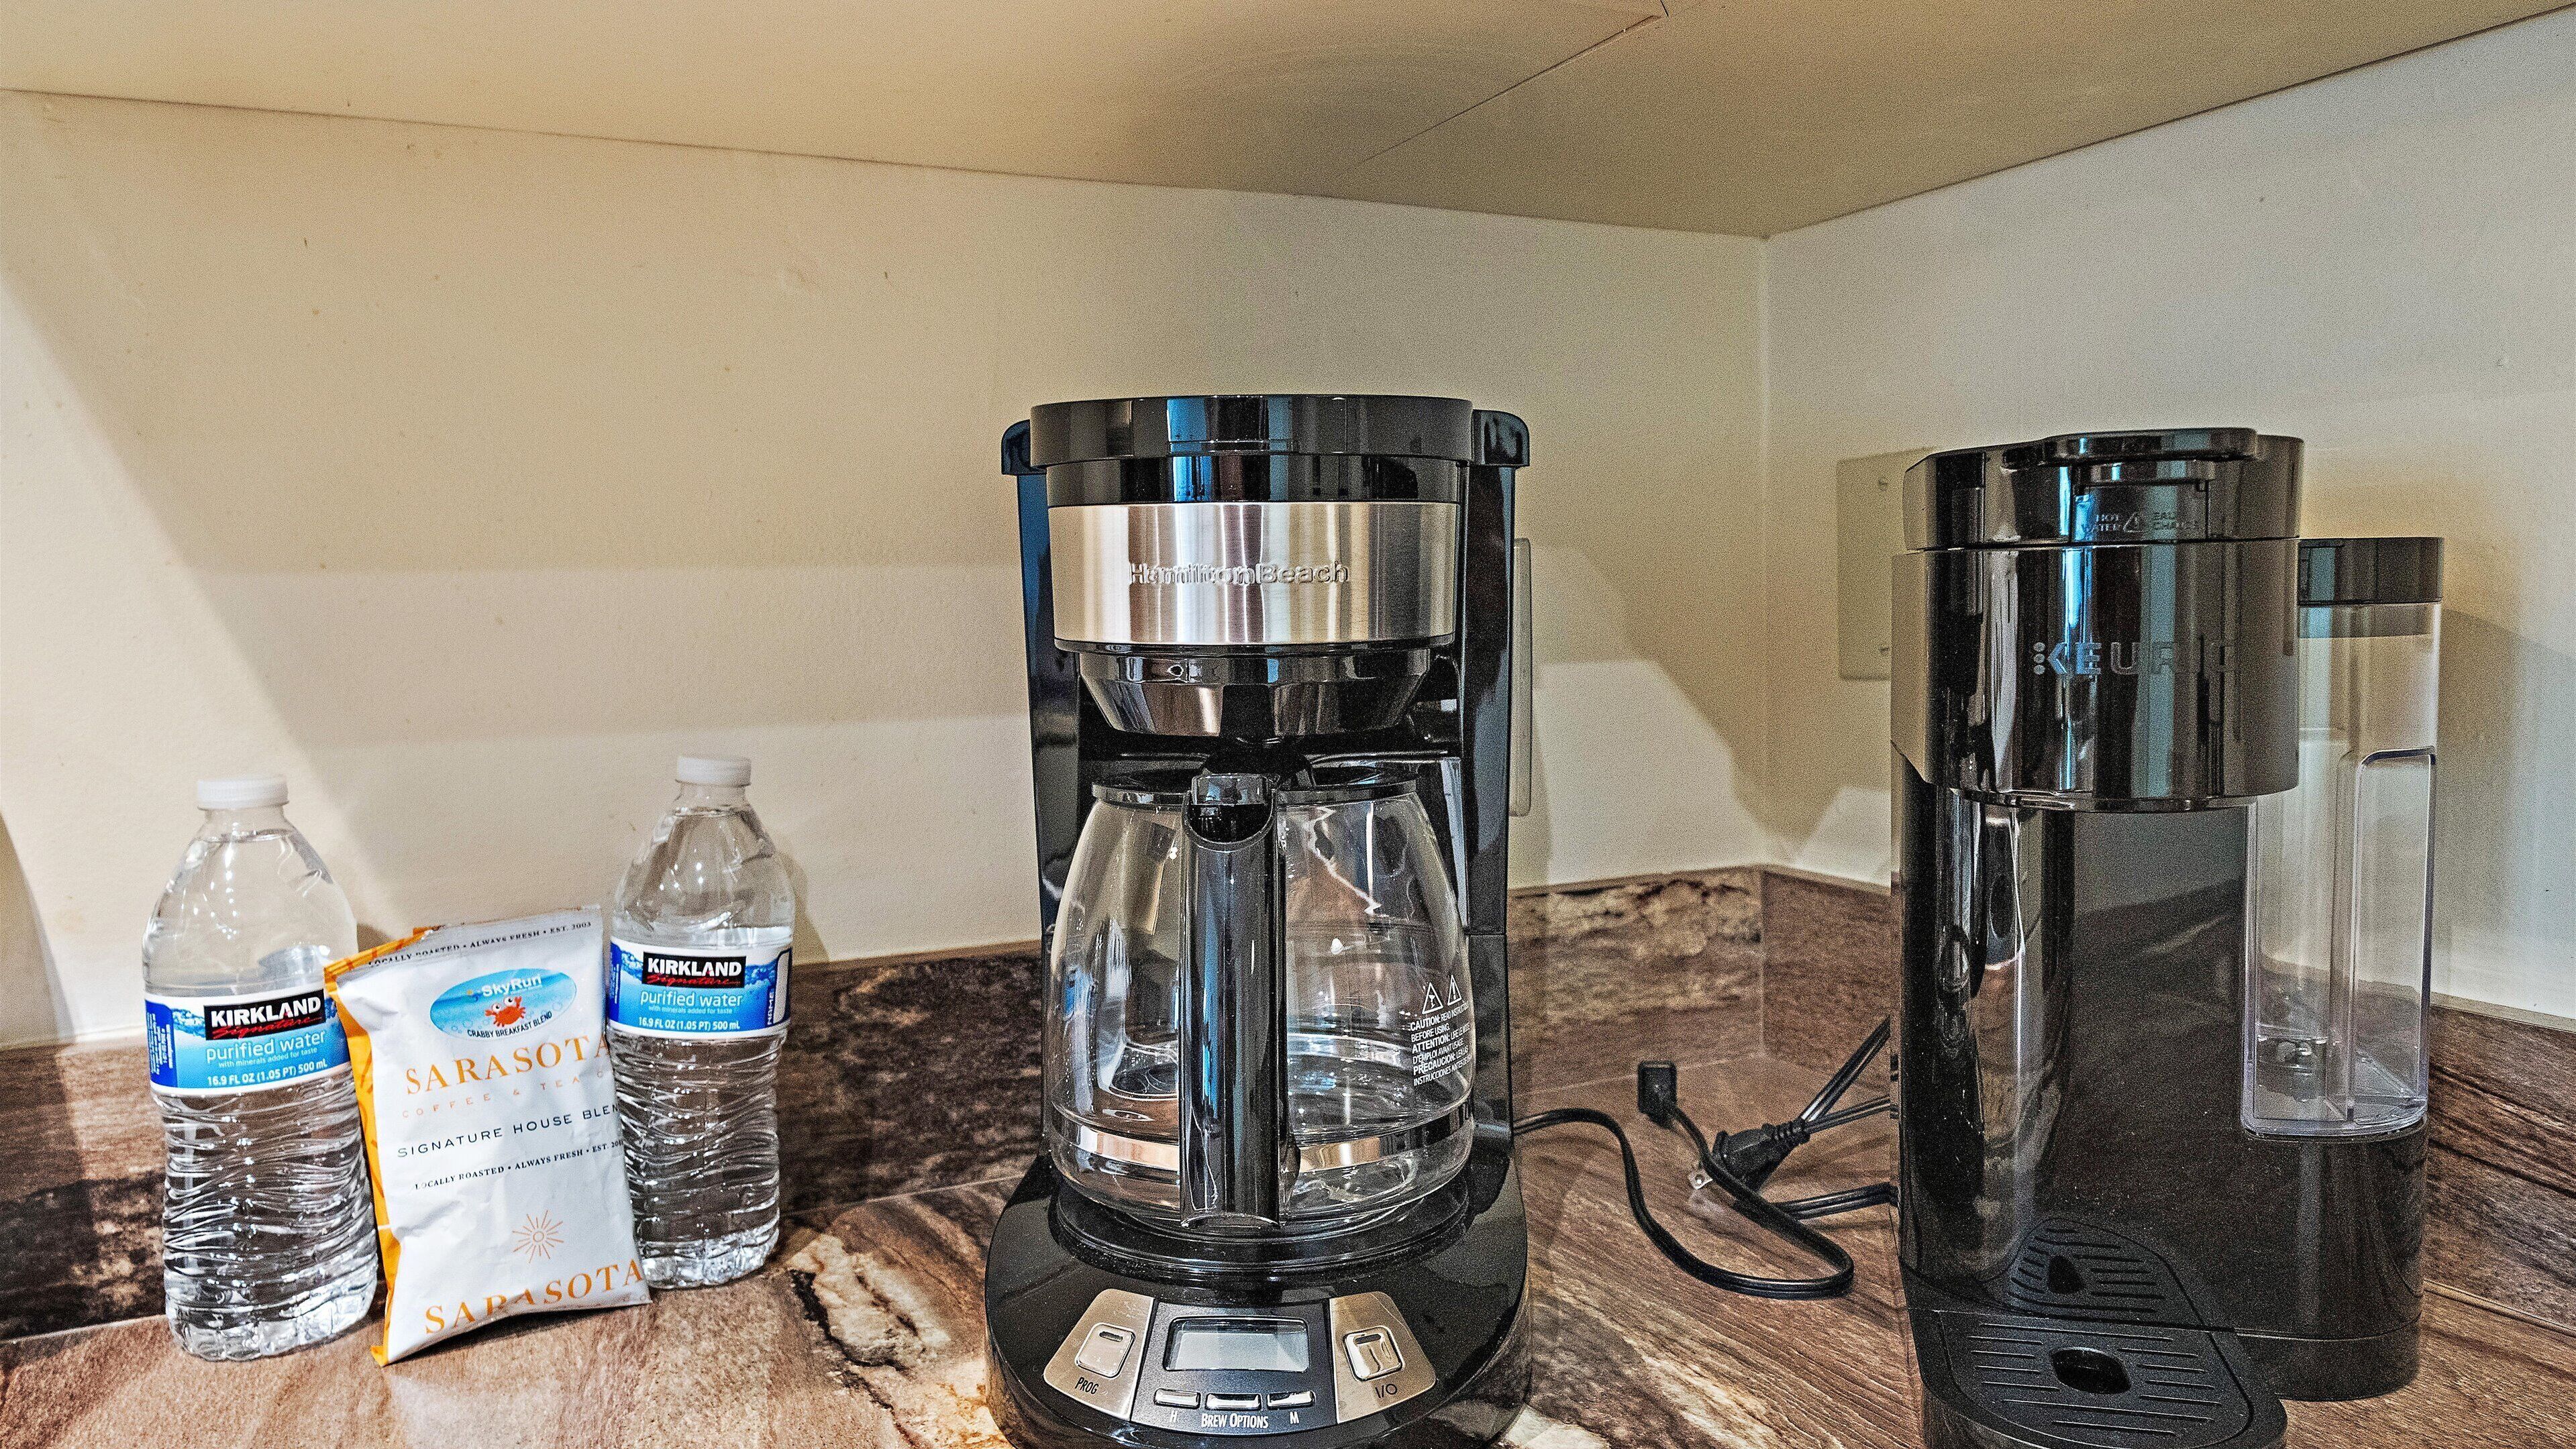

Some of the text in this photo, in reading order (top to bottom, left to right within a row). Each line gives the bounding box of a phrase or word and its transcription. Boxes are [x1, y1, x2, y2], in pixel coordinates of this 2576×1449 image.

[1257, 561, 1349, 584] Beach
[510, 930, 539, 940] FRESH
[648, 957, 742, 977] KIRKLAND
[482, 974, 542, 997] SkyRun
[646, 973, 741, 987] Signature
[641, 991, 743, 1007] purified water
[211, 996, 321, 1028] KIRKLAND
[1410, 1014, 1441, 1032] CAUTION:
[212, 1016, 322, 1039] Signature
[467, 1011, 552, 1038] CRABBY BREAKFAST BLEND
[639, 1016, 741, 1031] 16.9 FL OZ (1.05 PT) 500 mL
[1410, 1028, 1435, 1042] BEFORE
[1412, 1032, 1451, 1054] ATTENTION:
[206, 1030, 325, 1063] purified water
[236, 1057, 266, 1067] minerals
[268, 1053, 289, 1063] added
[301, 1047, 317, 1055] taste
[1412, 1049, 1438, 1065] D'EMPLOI
[1438, 1043, 1452, 1057] AVANT
[207, 1059, 328, 1086] 16.9 FL OZ (1.05 PT) 500 mL
[405, 1033, 610, 1095] SARASOTA
[1413, 1052, 1455, 1076] PRECAUCION:
[1413, 1065, 1451, 1086] INSTRUCCIONES
[403, 1093, 491, 1118] COFFEE
[539, 1077, 580, 1091] TEA
[398, 1104, 618, 1158] SIGNATURE HOUSE BLEN
[415, 1175, 456, 1191] LOCALLY
[459, 1166, 505, 1181] ROASTED
[515, 1156, 552, 1170] ALWAYS
[554, 1149, 584, 1163] FRESH
[593, 1143, 609, 1153] EST.
[425, 1259, 644, 1334] SARASOTA
[1074, 1377, 1099, 1395] PROG
[1170, 1411, 1178, 1423] H
[1201, 1412, 1269, 1429] BREW OPTIONS
[1290, 1411, 1300, 1424] M
